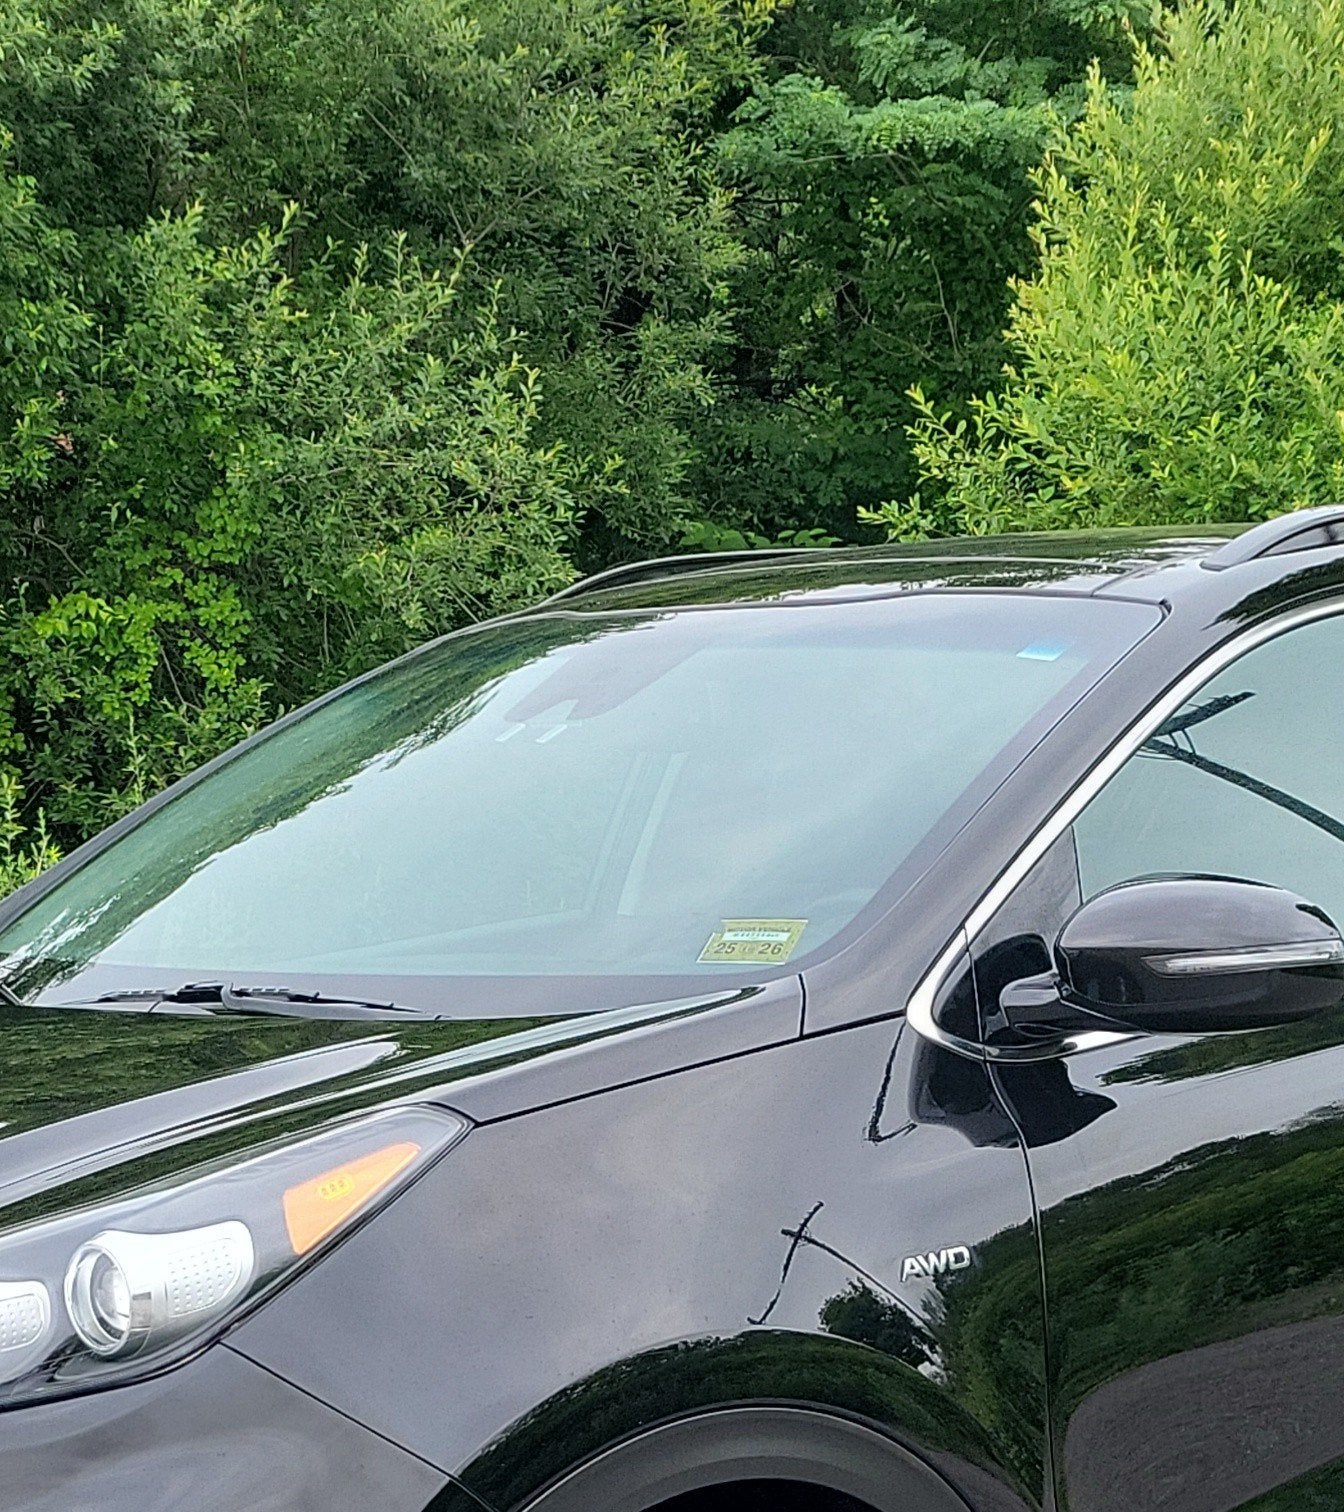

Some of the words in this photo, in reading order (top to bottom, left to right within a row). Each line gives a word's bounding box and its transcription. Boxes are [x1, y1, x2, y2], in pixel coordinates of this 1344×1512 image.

[714, 942, 737, 954] 25
[758, 942, 784, 954] 26
[901, 1245, 971, 1282] AWD
